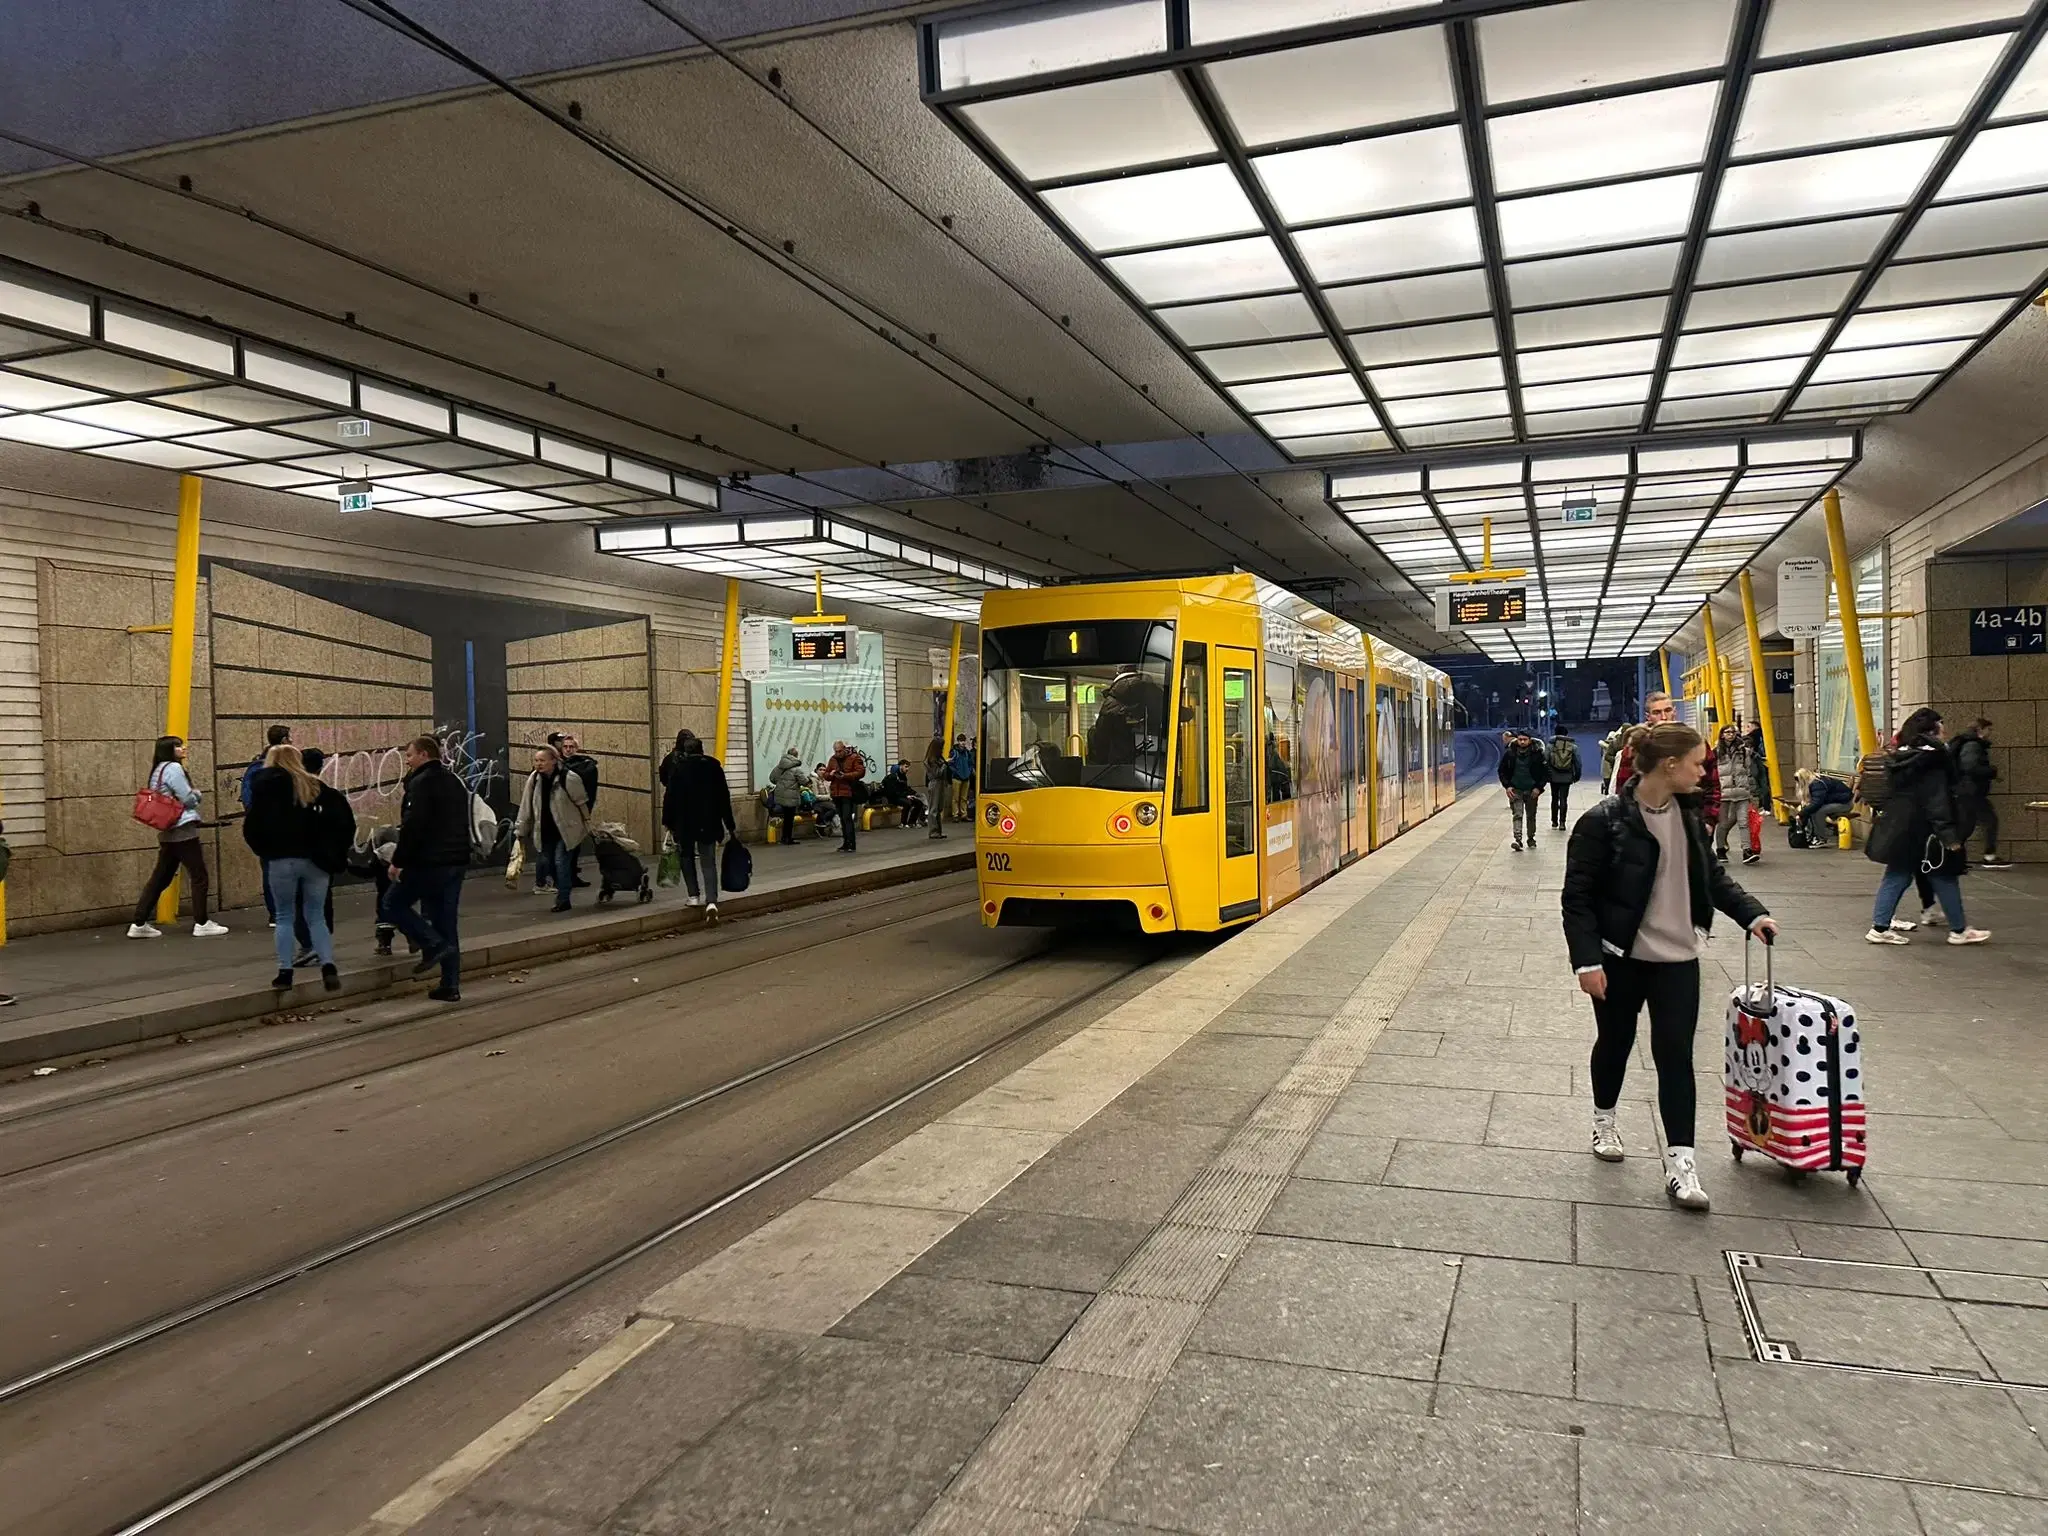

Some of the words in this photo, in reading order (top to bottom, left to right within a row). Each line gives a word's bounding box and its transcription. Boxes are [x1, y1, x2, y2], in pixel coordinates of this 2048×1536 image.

[1974, 608, 2042, 628] 4a-4b
[1068, 630, 1079, 654] 1
[985, 852, 1012, 872] 202
